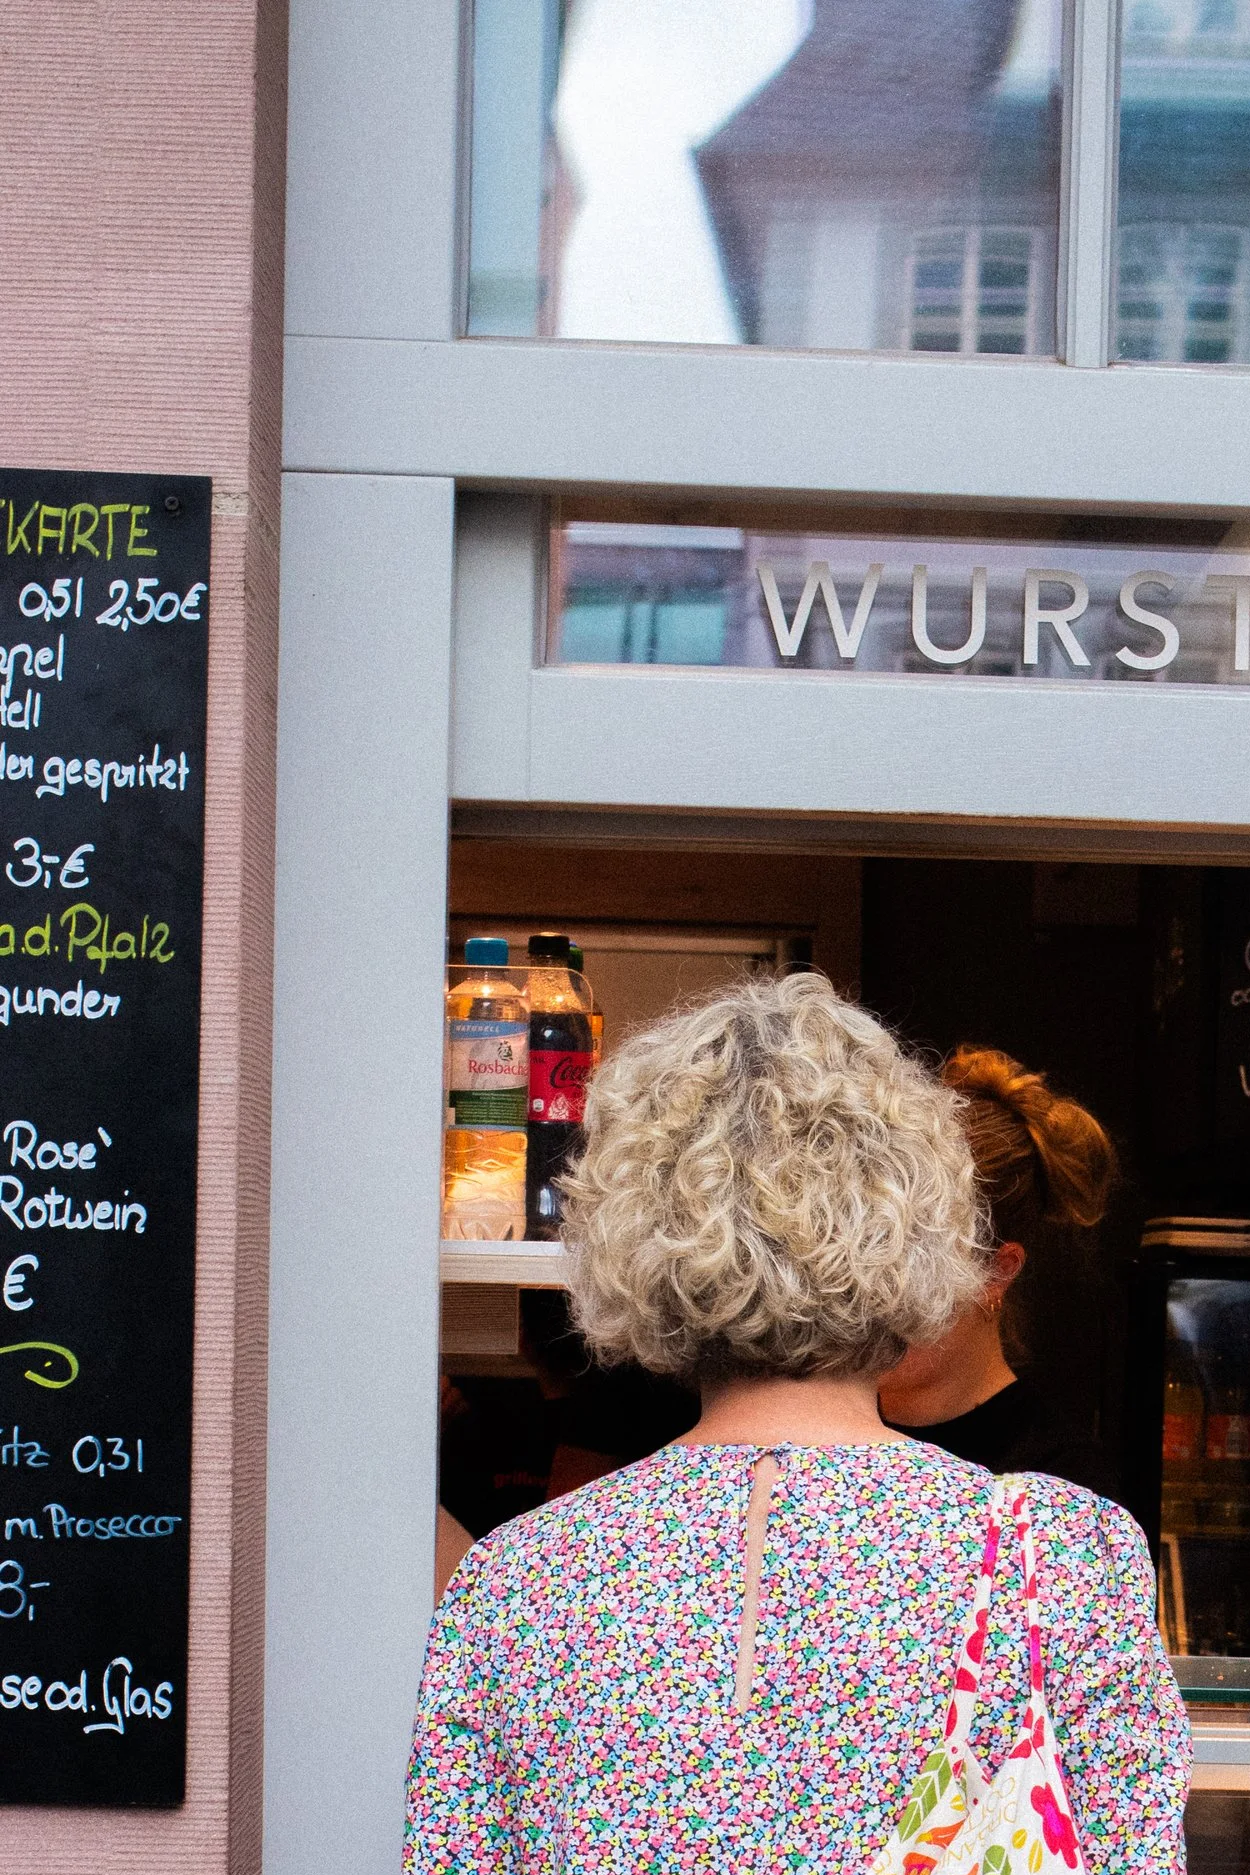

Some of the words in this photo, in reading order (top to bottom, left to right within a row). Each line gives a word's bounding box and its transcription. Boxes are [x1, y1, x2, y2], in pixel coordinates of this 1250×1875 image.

[0, 500, 158, 560] KARTE
[36, 743, 190, 803] gespritzt
[60, 902, 175, 975] Pfalz
[0, 1175, 147, 1234] Rotwein
[3, 1254, 39, 1311] €
[42, 1503, 182, 1540] Prosecco
[83, 1656, 173, 1735] Glas
